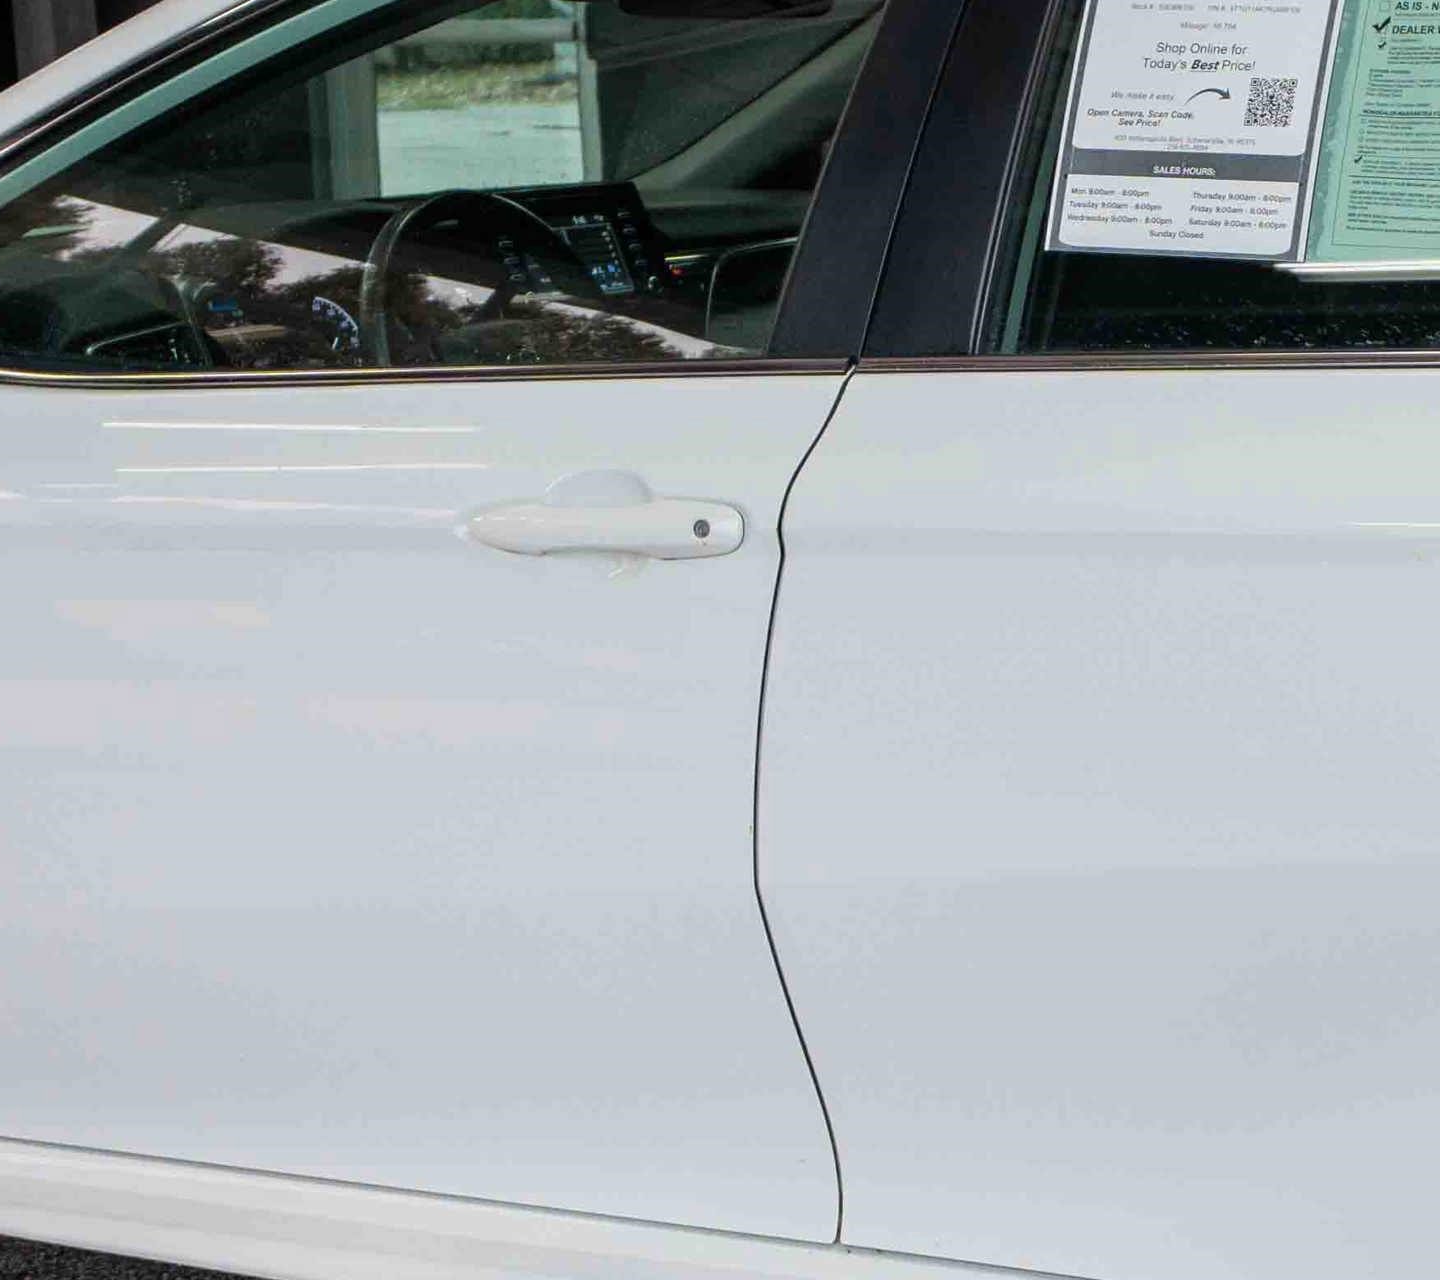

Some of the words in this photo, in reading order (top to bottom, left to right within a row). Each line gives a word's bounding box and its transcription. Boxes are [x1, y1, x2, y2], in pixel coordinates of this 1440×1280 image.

[1395, 1, 1410, 11] AS
[1412, 1, 1423, 11] IS
[1392, 25, 1435, 35] DEALER
[1156, 42, 1186, 56] Shop
[1190, 42, 1229, 55] Online
[1231, 43, 1247, 55] for
[1143, 57, 1187, 72] Today's
[1191, 59, 1220, 71] Best
[1221, 60, 1256, 72] Price!
[1087, 108, 1110, 118] Open
[1111, 109, 1145, 119] Camera,
[1147, 110, 1169, 119] Scan
[1118, 118, 1133, 127] See
[1135, 118, 1161, 128] Price!
[1152, 166, 1181, 176] SALES
[1182, 166, 1217, 177] HOURS:
[1193, 191, 1226, 202] Thursday
[1069, 201, 1098, 211] Tuesday
[1190, 204, 1213, 215] Friday
[1188, 219, 1222, 230] Saturday
[1149, 230, 1177, 241] Sunday
[1178, 231, 1204, 240] Closed
